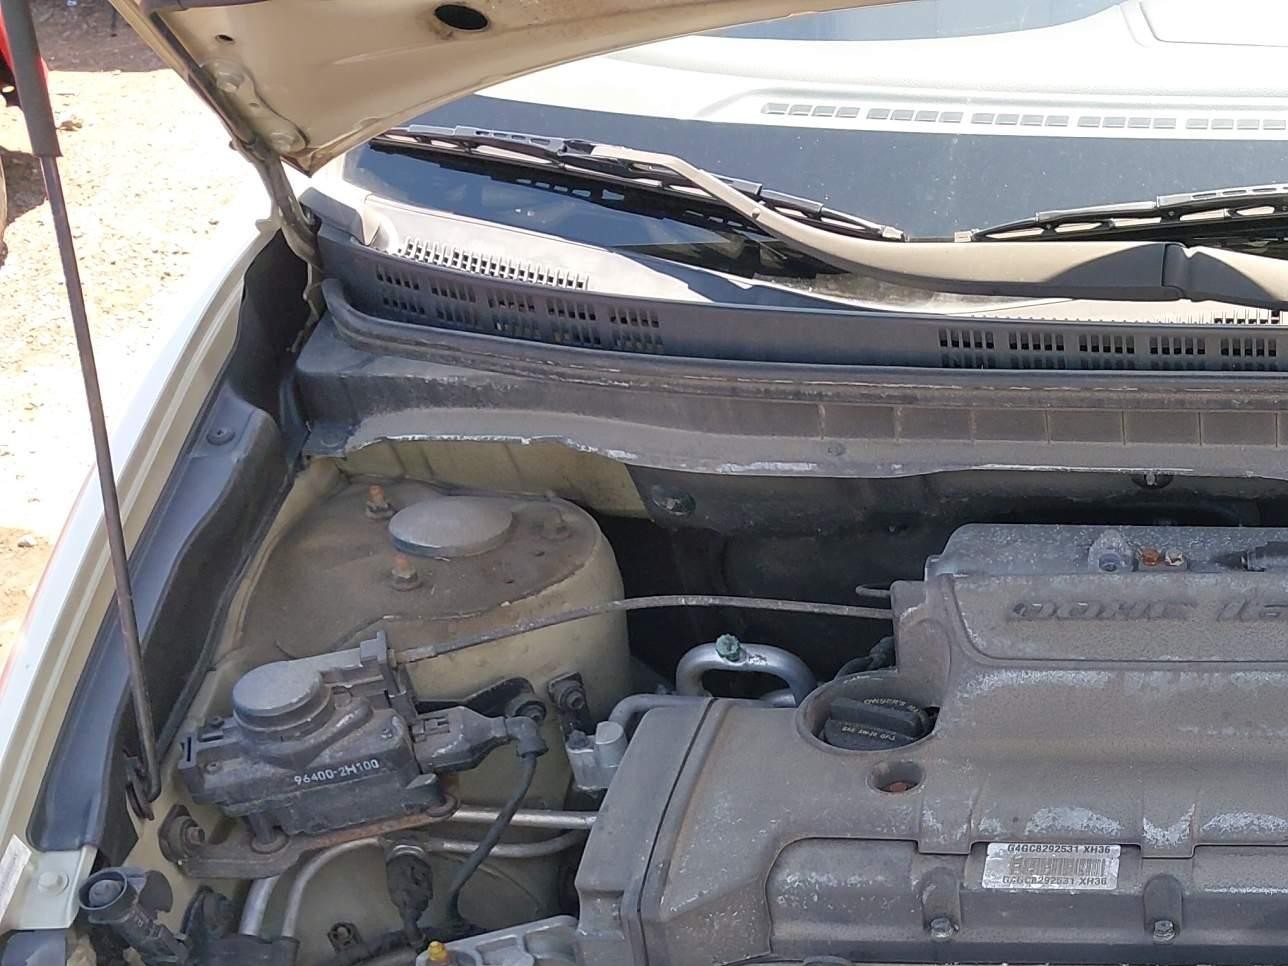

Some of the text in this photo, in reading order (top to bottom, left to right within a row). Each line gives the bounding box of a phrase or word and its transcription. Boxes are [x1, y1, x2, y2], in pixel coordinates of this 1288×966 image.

[294, 759, 380, 785] 96400-2H100
[1007, 844, 1111, 854] G4GC8292531 XH36
